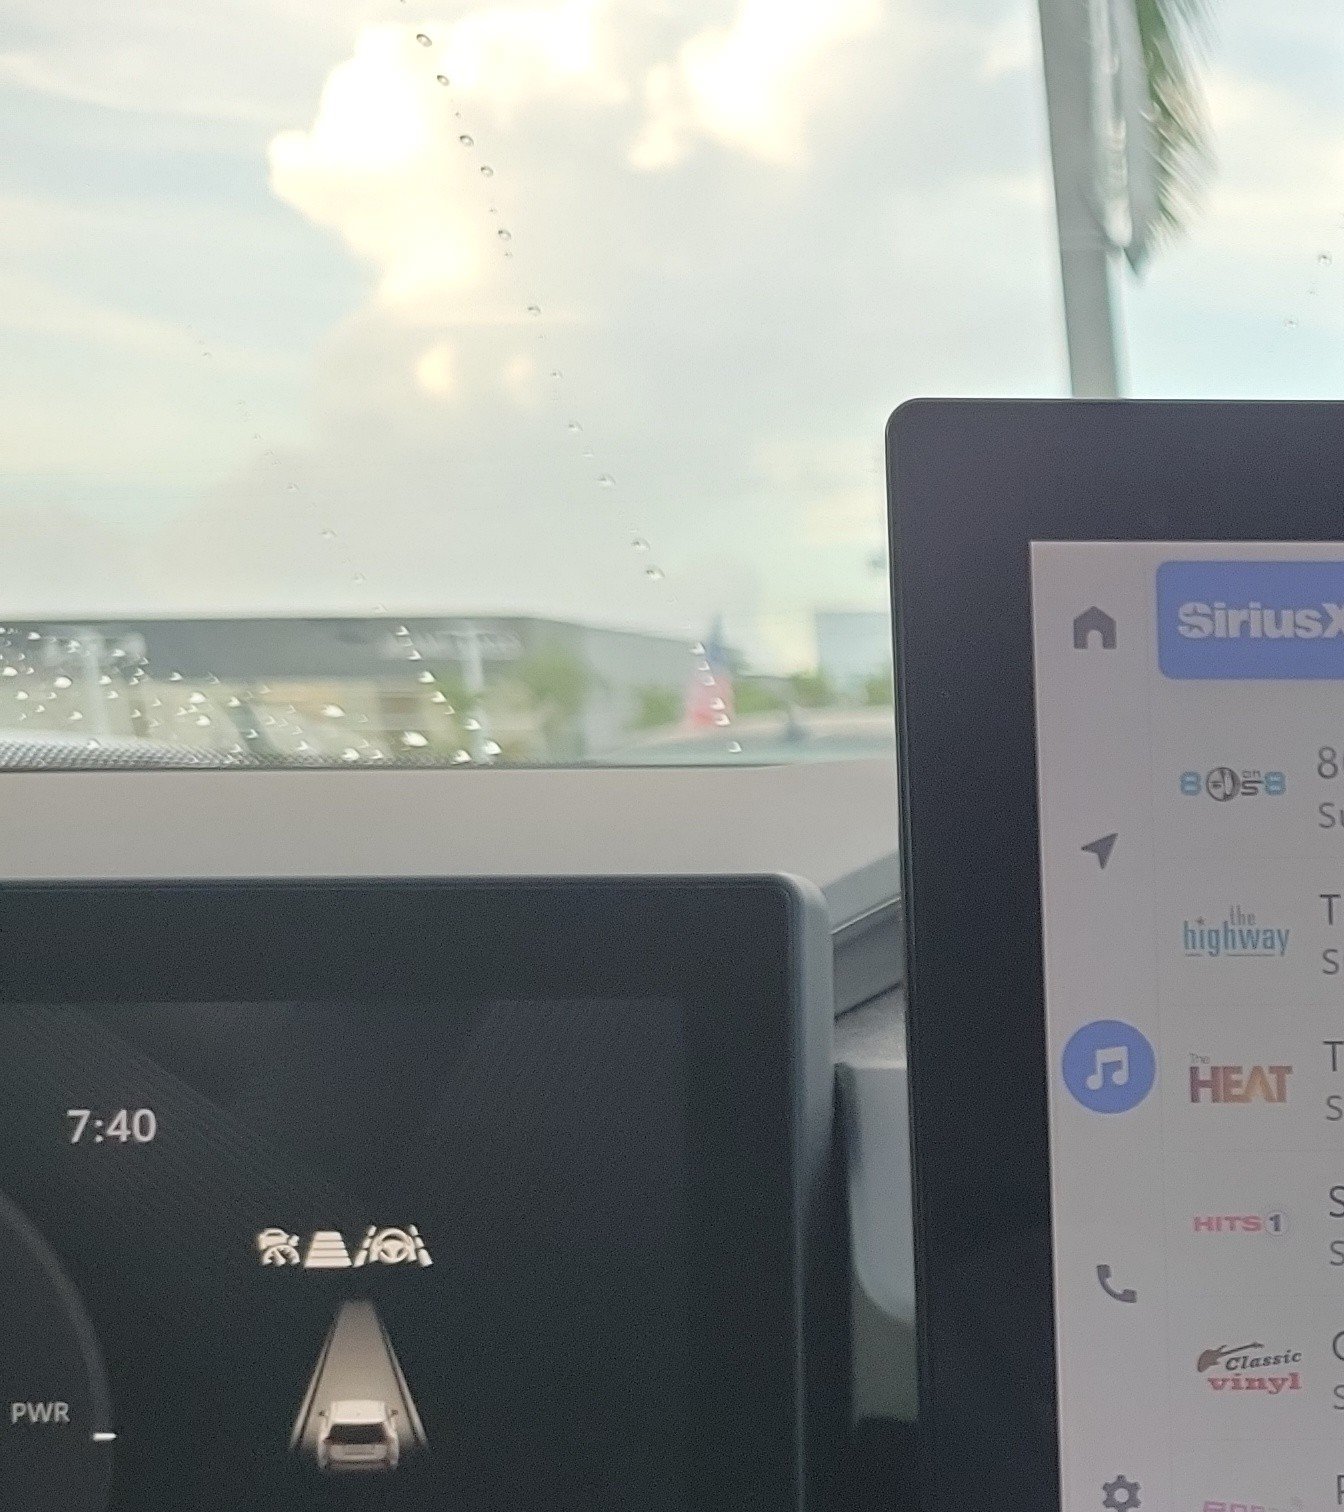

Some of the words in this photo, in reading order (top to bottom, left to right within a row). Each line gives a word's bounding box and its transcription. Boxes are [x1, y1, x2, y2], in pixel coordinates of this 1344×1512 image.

[1184, 920, 1290, 957] highway
[1190, 1065, 1294, 1103] HEAT
[66, 1109, 158, 1144] 7:40
[1225, 1350, 1302, 1371] Classic
[1207, 1373, 1302, 1395] vinyl
[10, 1400, 71, 1425] PWR
